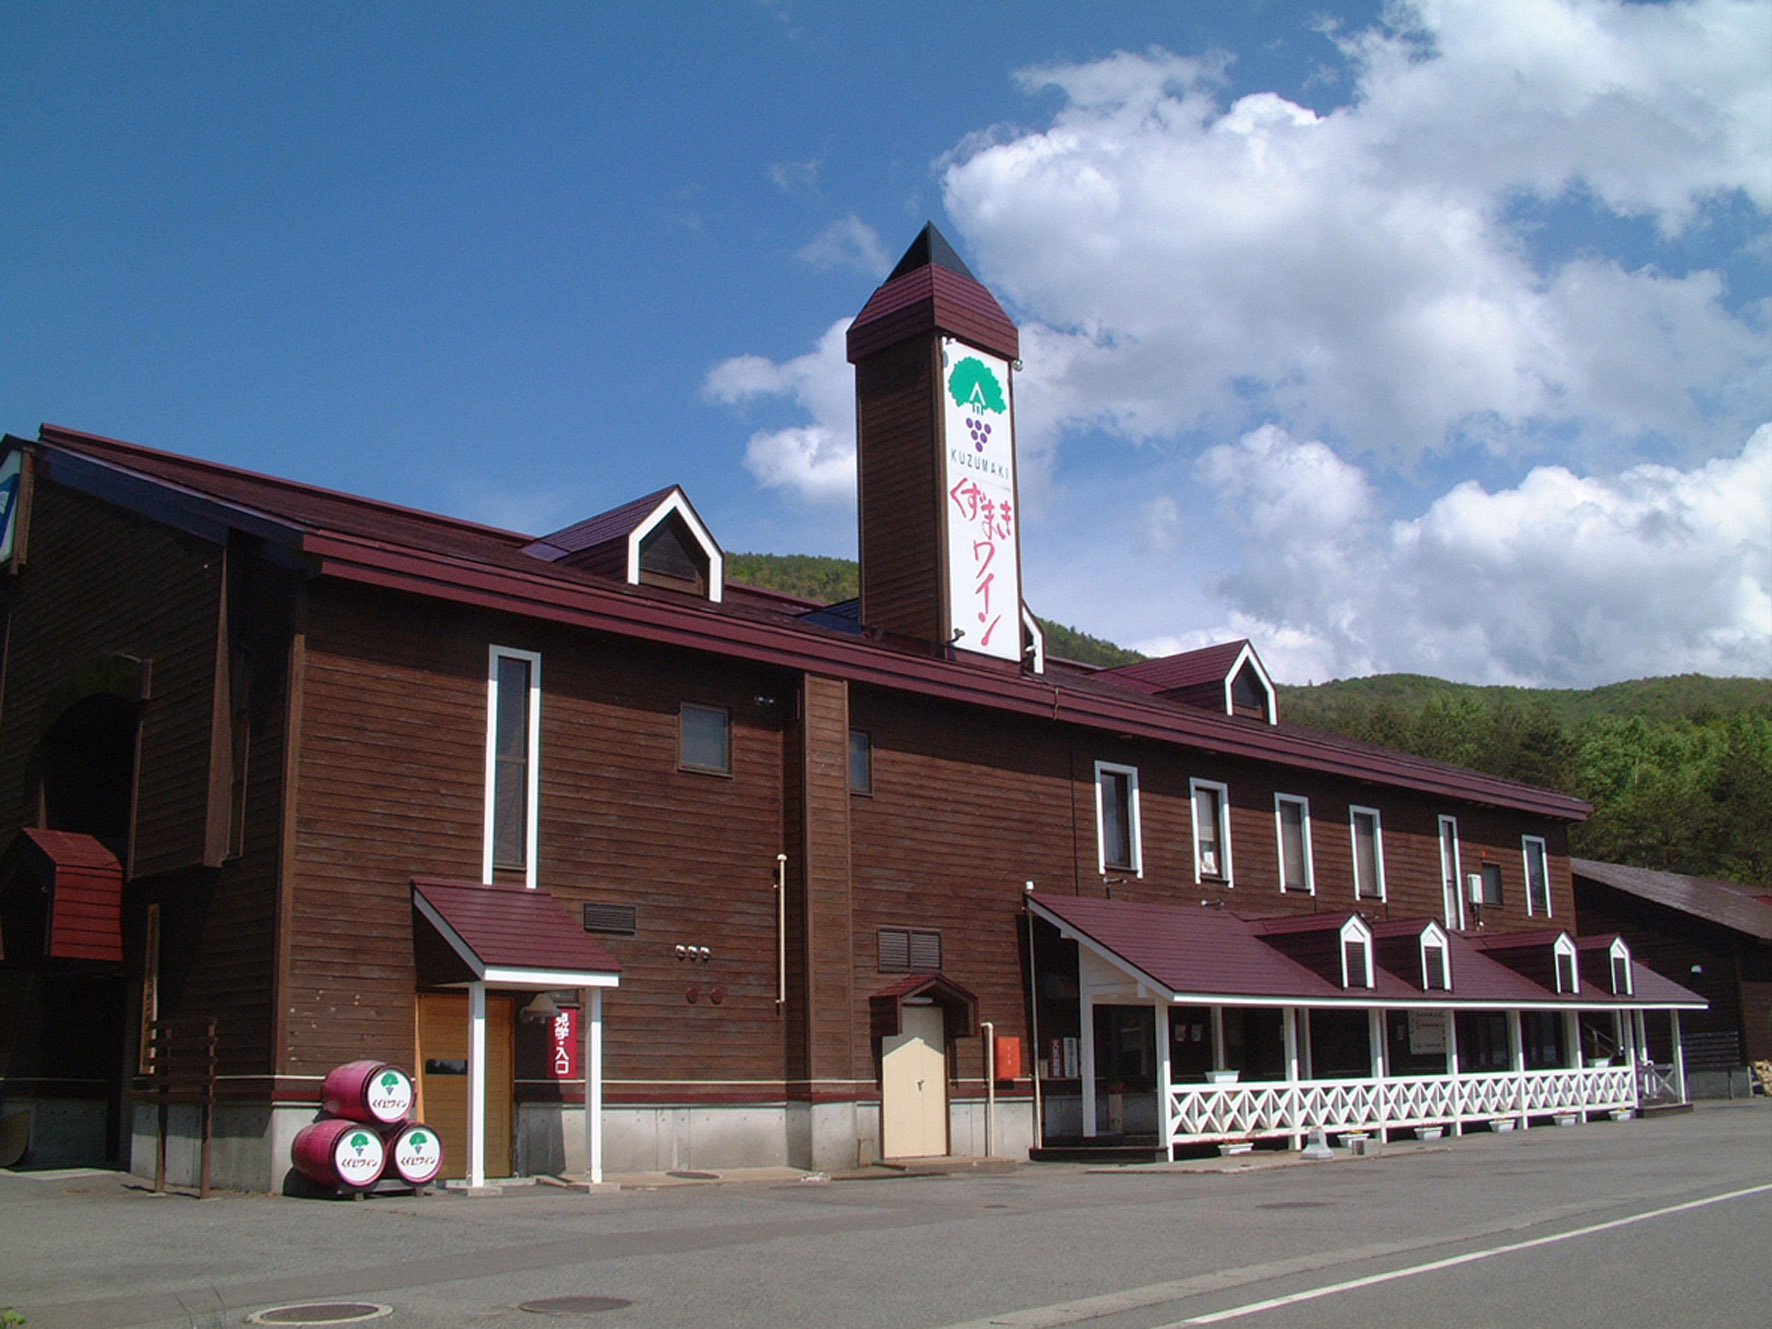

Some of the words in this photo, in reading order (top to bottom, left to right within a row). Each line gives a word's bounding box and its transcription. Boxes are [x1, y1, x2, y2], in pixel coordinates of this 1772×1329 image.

[950, 448, 1010, 480] KUZUMAKI
[950, 477, 1012, 540] くずまき
[973, 540, 1002, 646] ワイン
